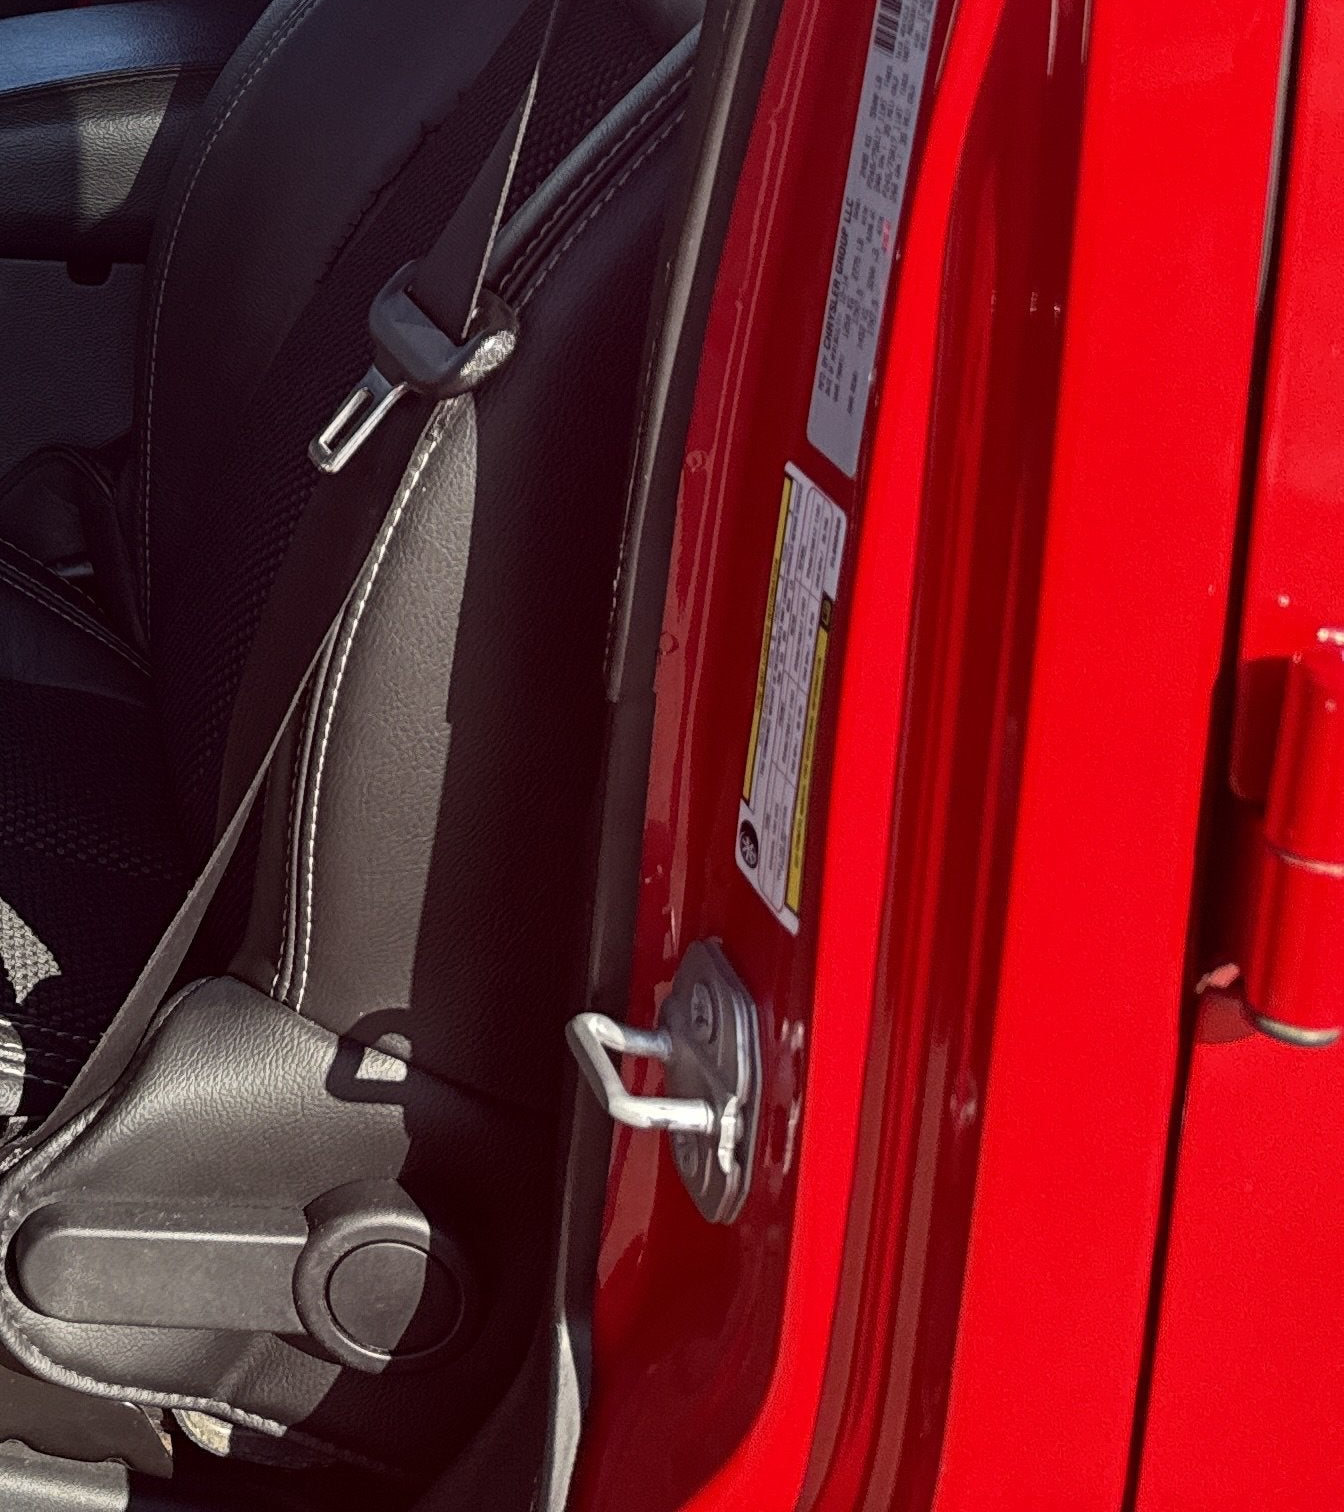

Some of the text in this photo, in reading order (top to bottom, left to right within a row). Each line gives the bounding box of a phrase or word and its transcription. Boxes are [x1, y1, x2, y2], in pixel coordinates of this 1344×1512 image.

[824, 278, 840, 350] CHRYSLER
[835, 227, 849, 274] GROUP
[844, 198, 854, 223] LLC
